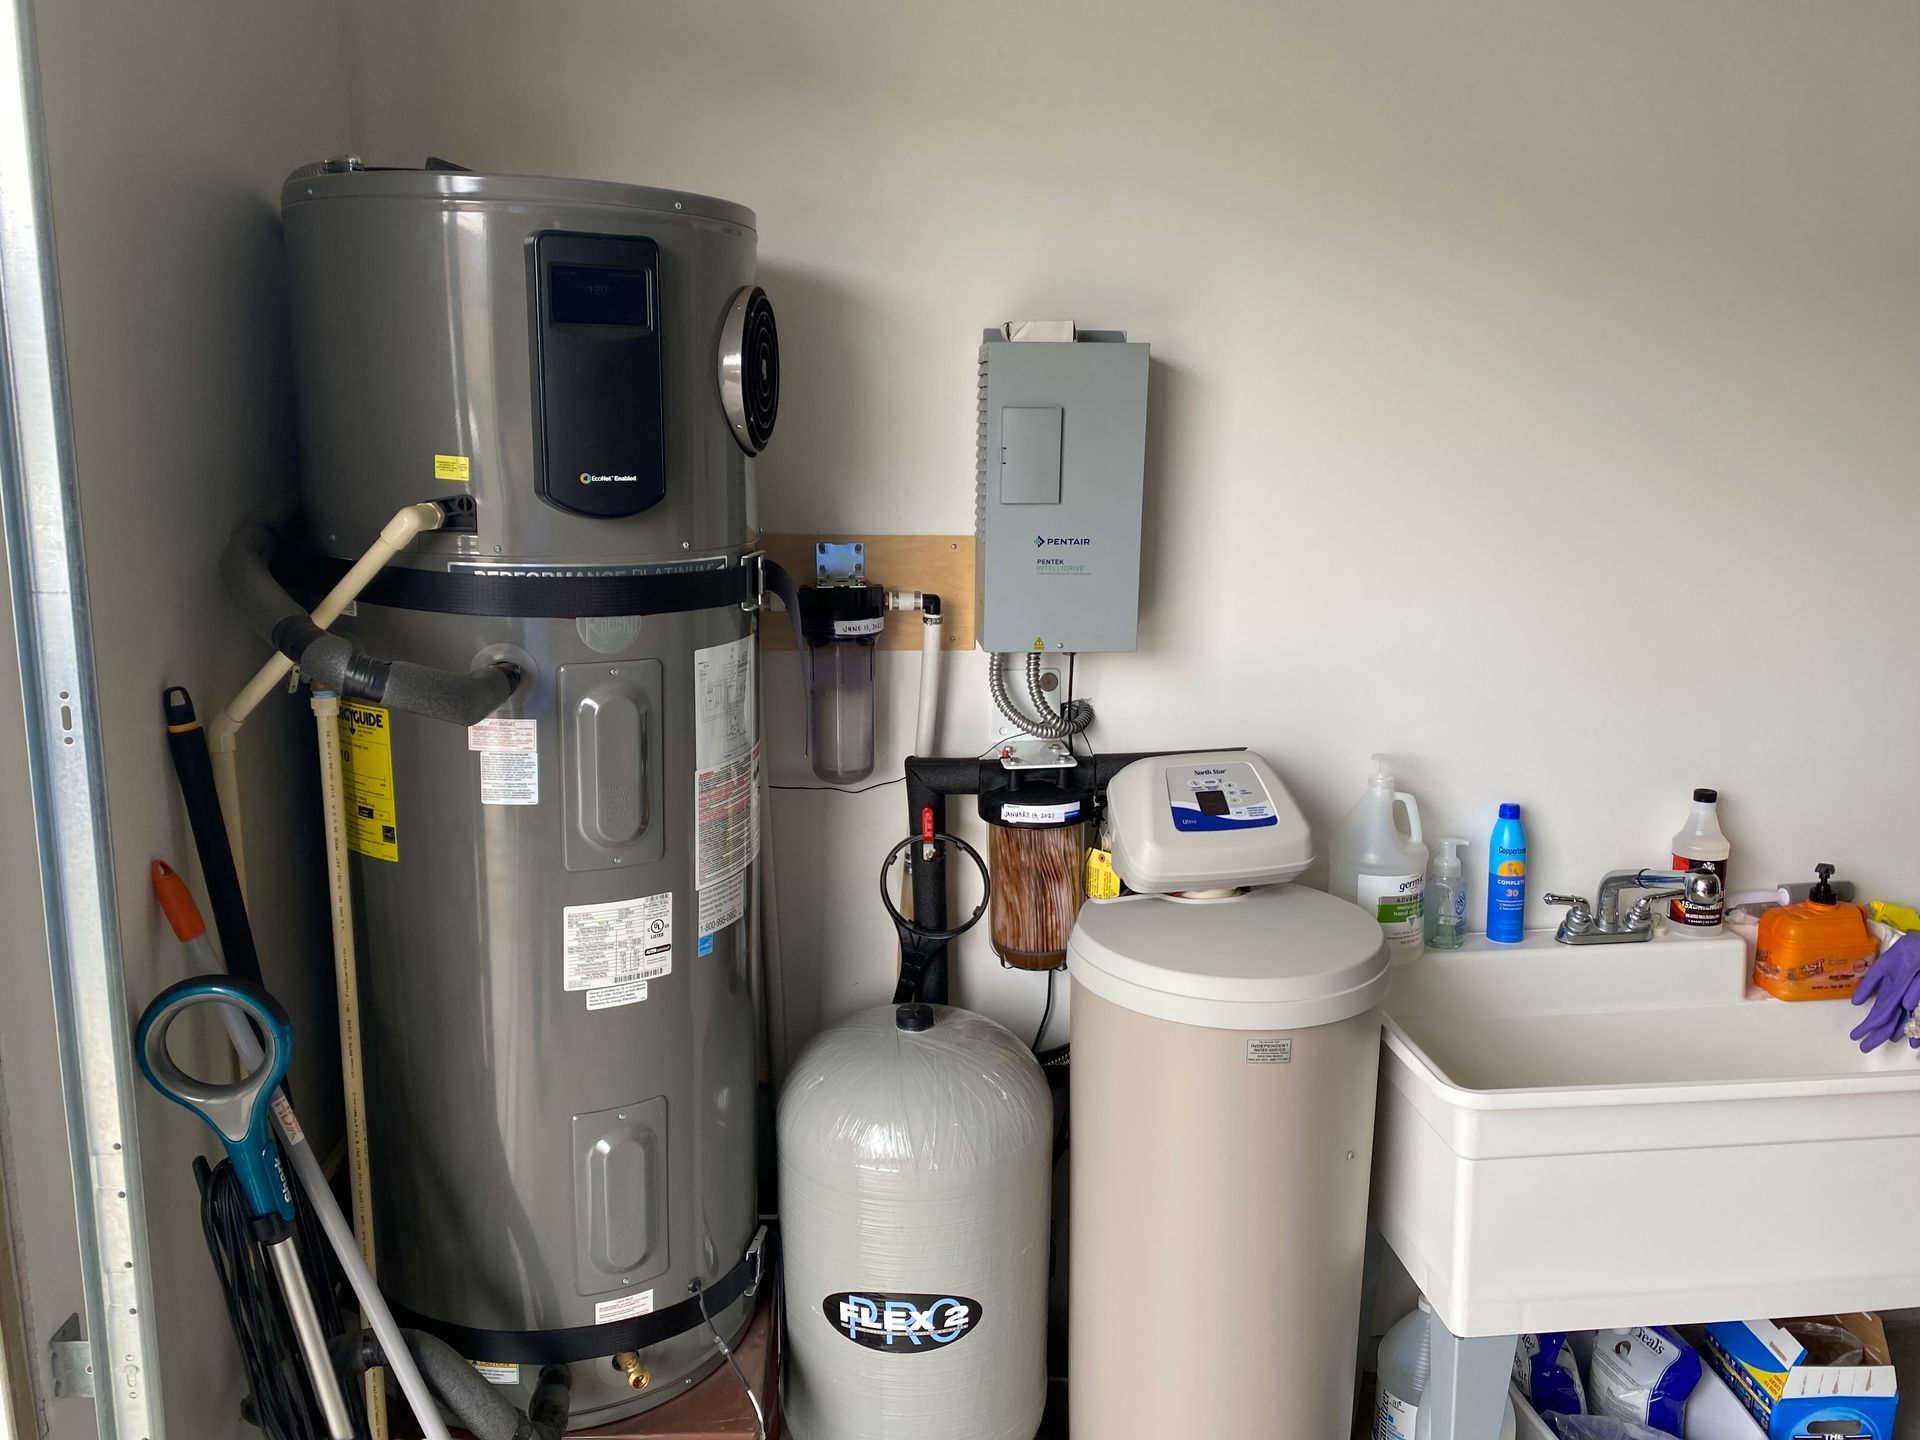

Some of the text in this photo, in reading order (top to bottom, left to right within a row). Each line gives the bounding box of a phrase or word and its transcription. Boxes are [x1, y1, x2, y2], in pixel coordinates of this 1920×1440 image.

[1047, 538, 1091, 546] PENTAIR
[1506, 889, 1519, 897] 30
[274, 1156, 291, 1203] Shark
[839, 1301, 935, 1331] FLEX
[944, 1305, 969, 1327] 2
